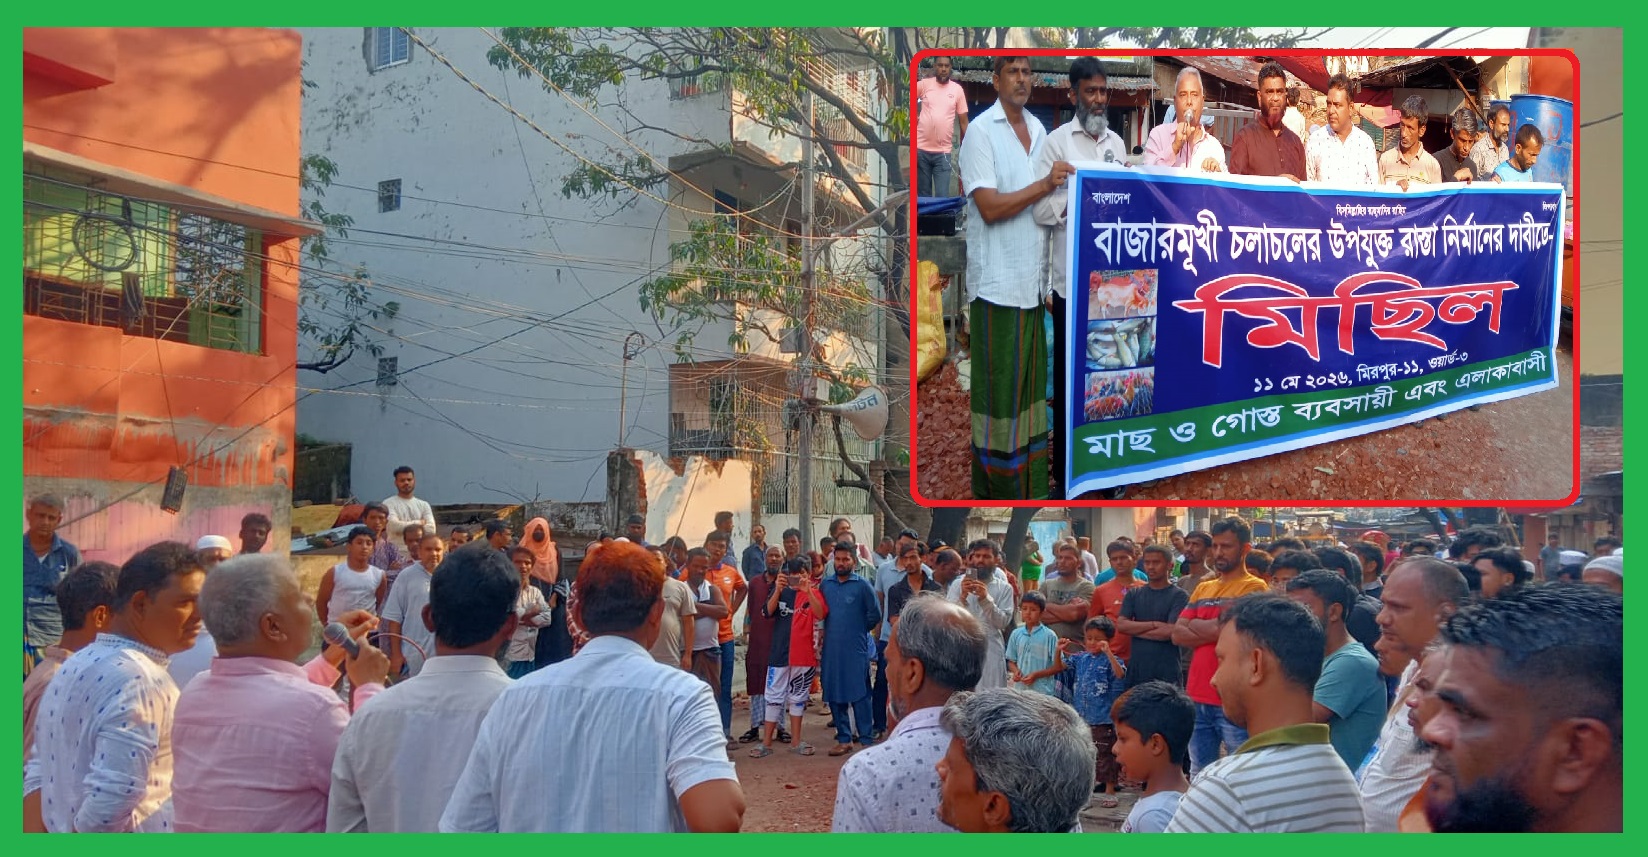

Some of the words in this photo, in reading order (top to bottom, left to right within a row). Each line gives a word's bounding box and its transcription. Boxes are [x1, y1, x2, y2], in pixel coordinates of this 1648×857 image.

[1092, 190, 1131, 205] বাংলাদেশ
[1228, 223, 1322, 264] চলাচলের
[1326, 218, 1394, 270] উপযুক্ত
[1398, 222, 1438, 259] রাস্তা
[1441, 212, 1505, 256] নির্মানের
[1172, 271, 1520, 369] মিছিল
[1254, 377, 1274, 392] ১১
[1281, 375, 1301, 390] মে
[1305, 372, 1353, 387] ২০২৬,
[1356, 359, 1424, 382] মিরপুর-১১,
[1428, 349, 1469, 369] ওয়ার্ড-৩
[1082, 428, 1158, 458] মাছ
[1168, 422, 1196, 443] ও
[1211, 405, 1285, 438] গোস্ত
[1292, 385, 1399, 421] ব্যবসায়ী
[1404, 379, 1448, 401] এবং
[1455, 350, 1548, 388] এলাকাবাসী
